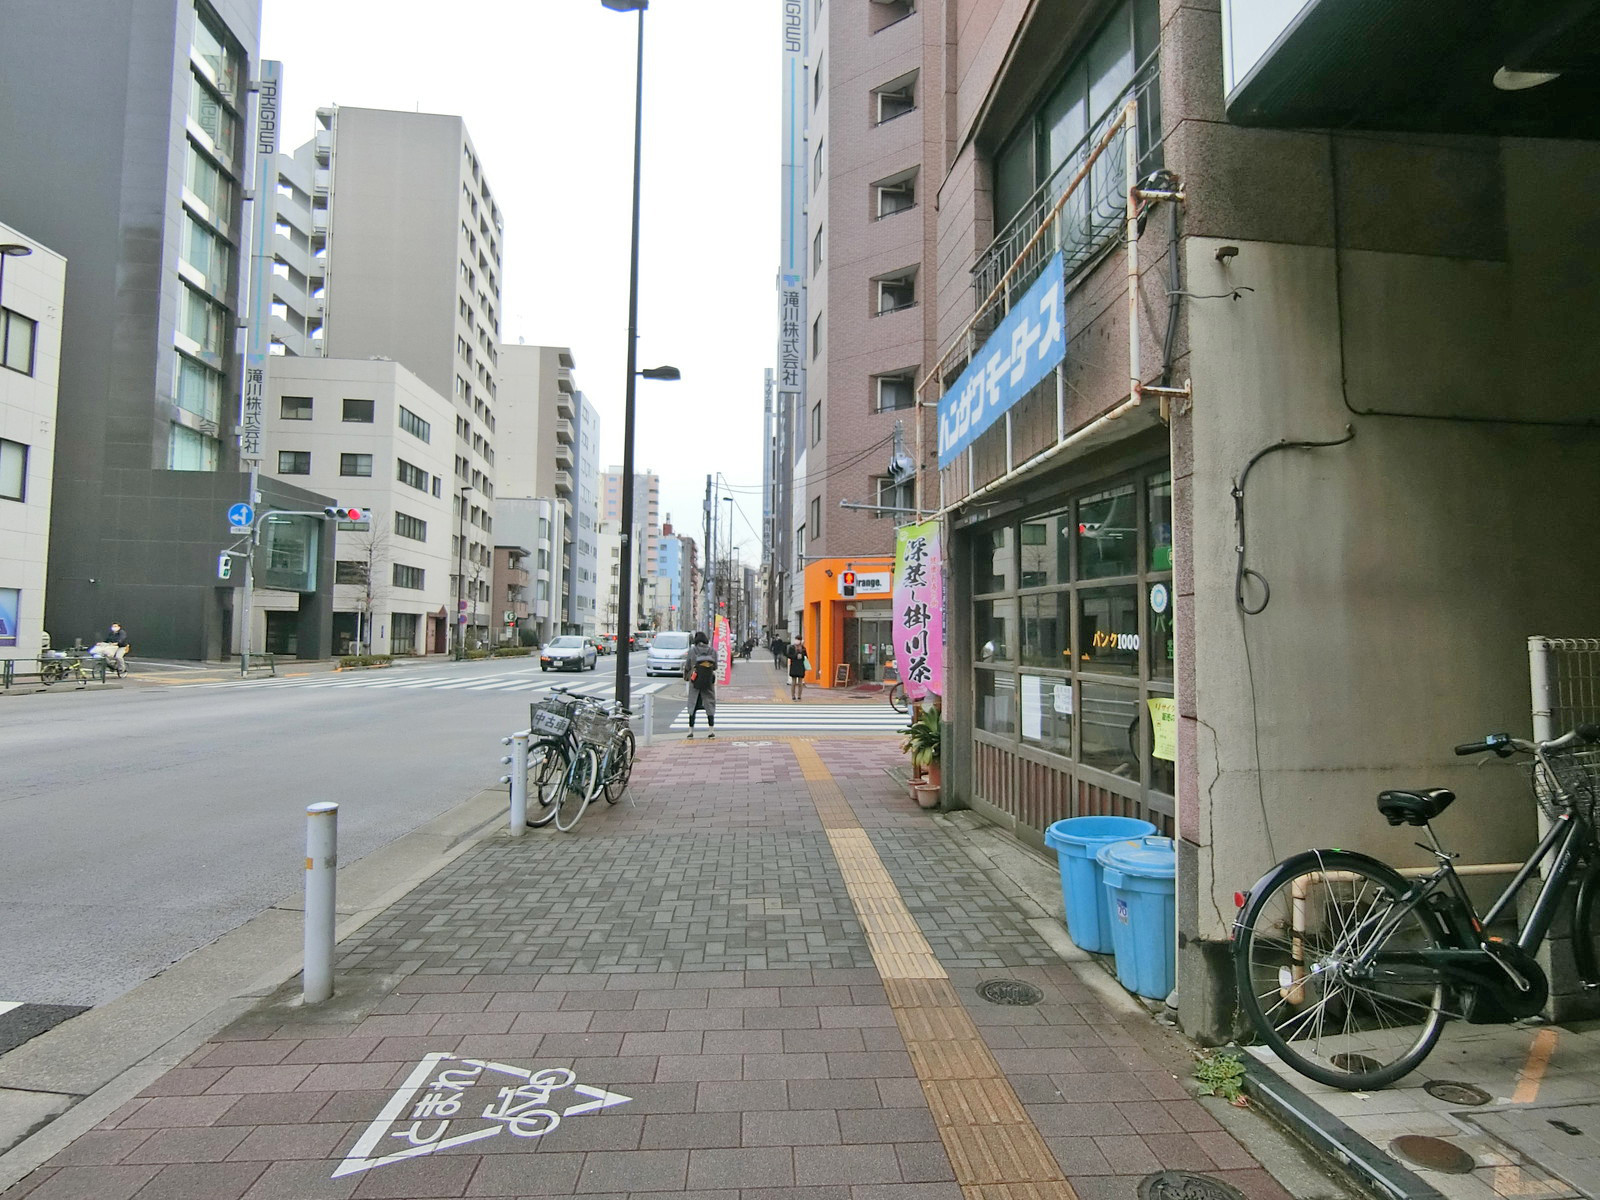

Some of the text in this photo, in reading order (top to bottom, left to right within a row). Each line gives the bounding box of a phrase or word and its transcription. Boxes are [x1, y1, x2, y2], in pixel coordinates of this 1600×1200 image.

[258, 79, 277, 155] TAKIGAWA
[783, 291, 799, 386] 滝川株式会社
[244, 368, 264, 454] 滝川株式会社
[856, 579, 882, 587] range.
[904, 536, 931, 684] 深蒸し掛川茶
[535, 712, 567, 732] 中古車
[391, 1066, 482, 1145] とまれ
